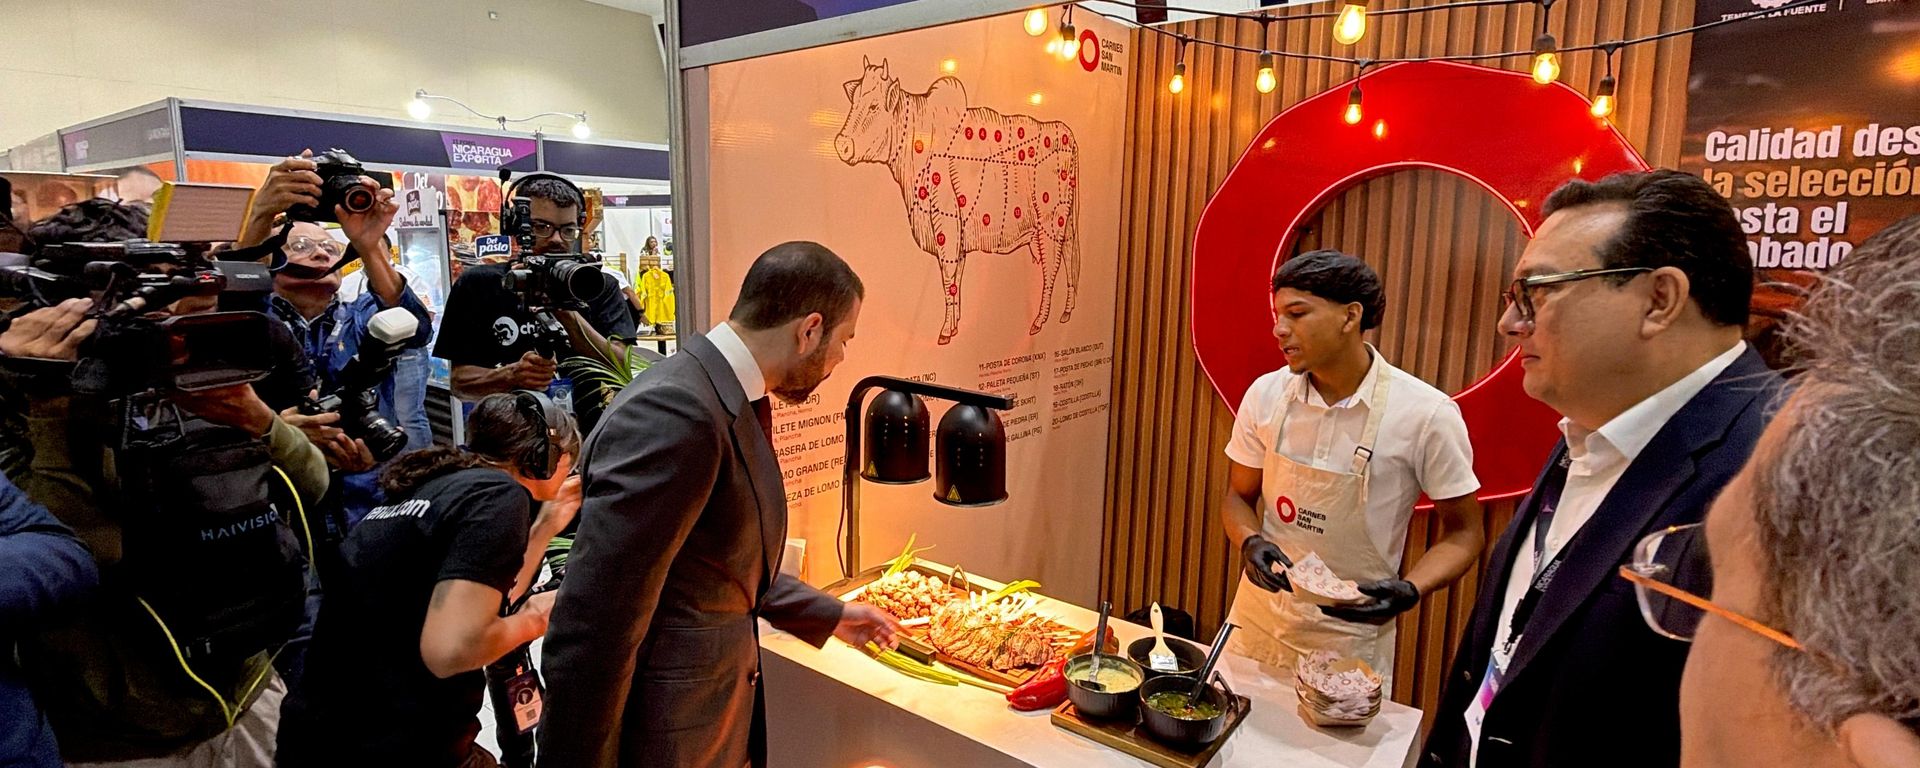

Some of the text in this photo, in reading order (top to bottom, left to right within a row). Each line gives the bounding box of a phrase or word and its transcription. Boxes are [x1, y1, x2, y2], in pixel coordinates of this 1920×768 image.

[1783, 4, 1826, 16] FUENTE
[1101, 38, 1123, 54] CARNES
[1101, 50, 1113, 62] SAN
[1101, 61, 1122, 76] MARTIN
[452, 144, 513, 157] NICARAGUA
[1705, 125, 1842, 162] Calidad
[453, 153, 503, 165] EXPORTA
[1811, 201, 1848, 234] el
[979, 360, 1003, 370] 11-POSTA
[1003, 358, 1011, 367] DE
[1011, 354, 1032, 365] CORONA
[978, 378, 1006, 390] 12-PALETA
[1006, 372, 1029, 384] PEQUEÑA
[798, 414, 832, 430] MIGNON
[1010, 415, 1028, 425] PIEDRA
[808, 440, 820, 450] DE
[821, 434, 844, 448] LOMO
[1010, 429, 1031, 441] GALLINA
[795, 460, 829, 477] GRANDE
[804, 486, 815, 498] DE
[816, 479, 840, 494] LOMO
[1297, 507, 1326, 521] CARNES
[1297, 514, 1312, 524] SAN
[1296, 520, 1324, 534] MARTIN
